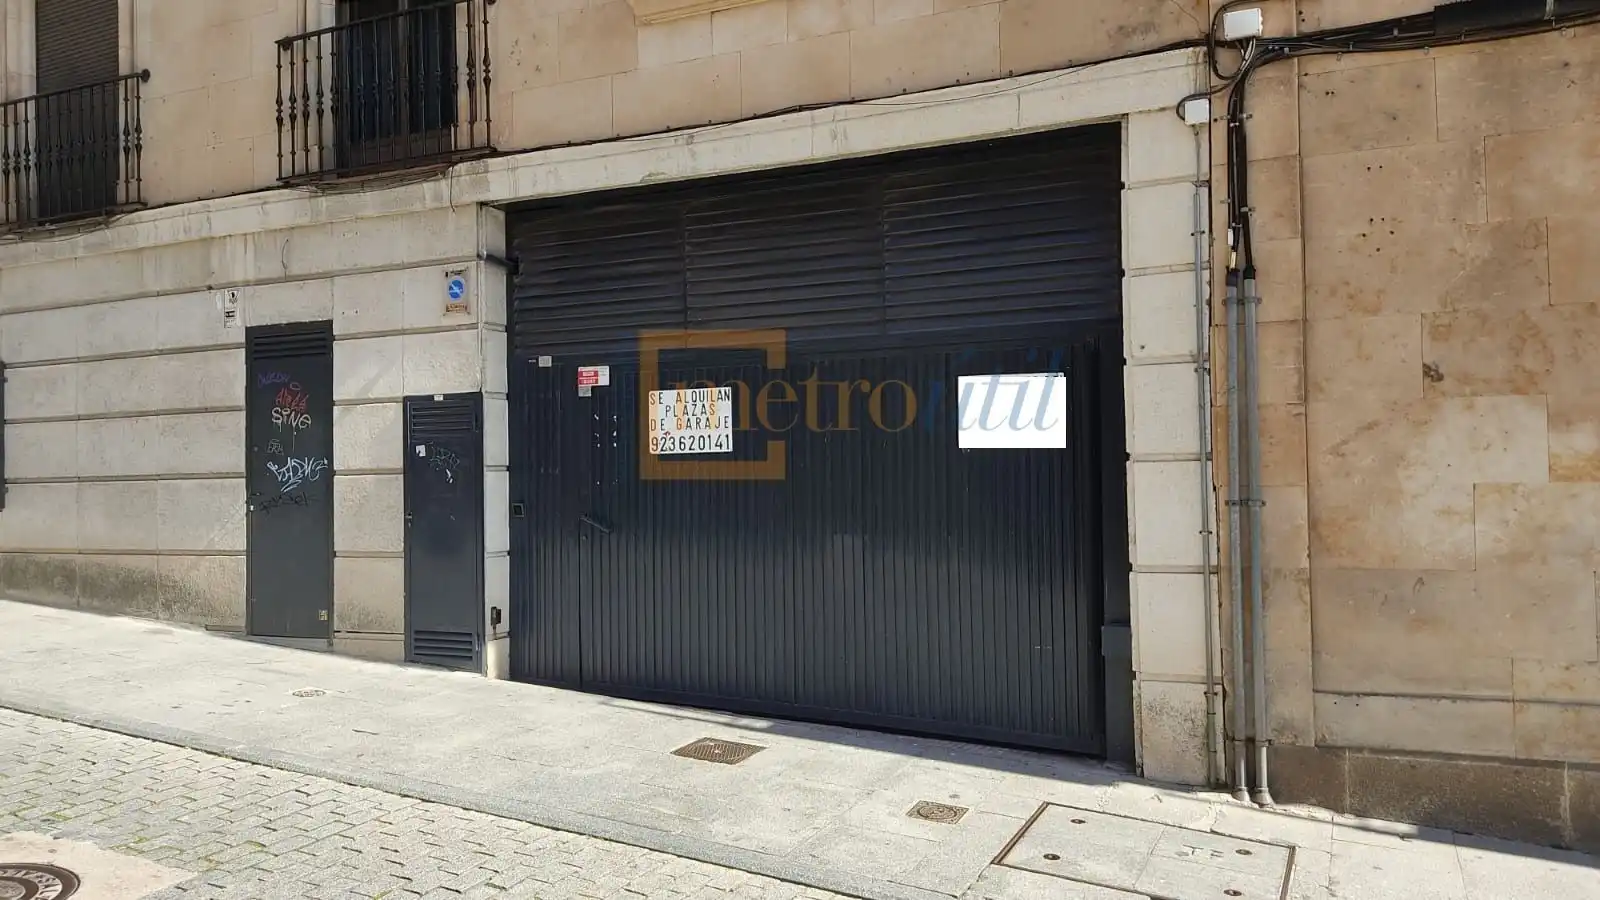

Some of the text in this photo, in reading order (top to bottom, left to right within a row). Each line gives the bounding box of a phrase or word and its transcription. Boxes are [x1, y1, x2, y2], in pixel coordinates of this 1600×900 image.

[649, 388, 731, 405] SE ALQUILAN
[665, 403, 715, 417] PLAZAS
[650, 416, 729, 431] DE GARAJE
[651, 434, 730, 452] 923620141
